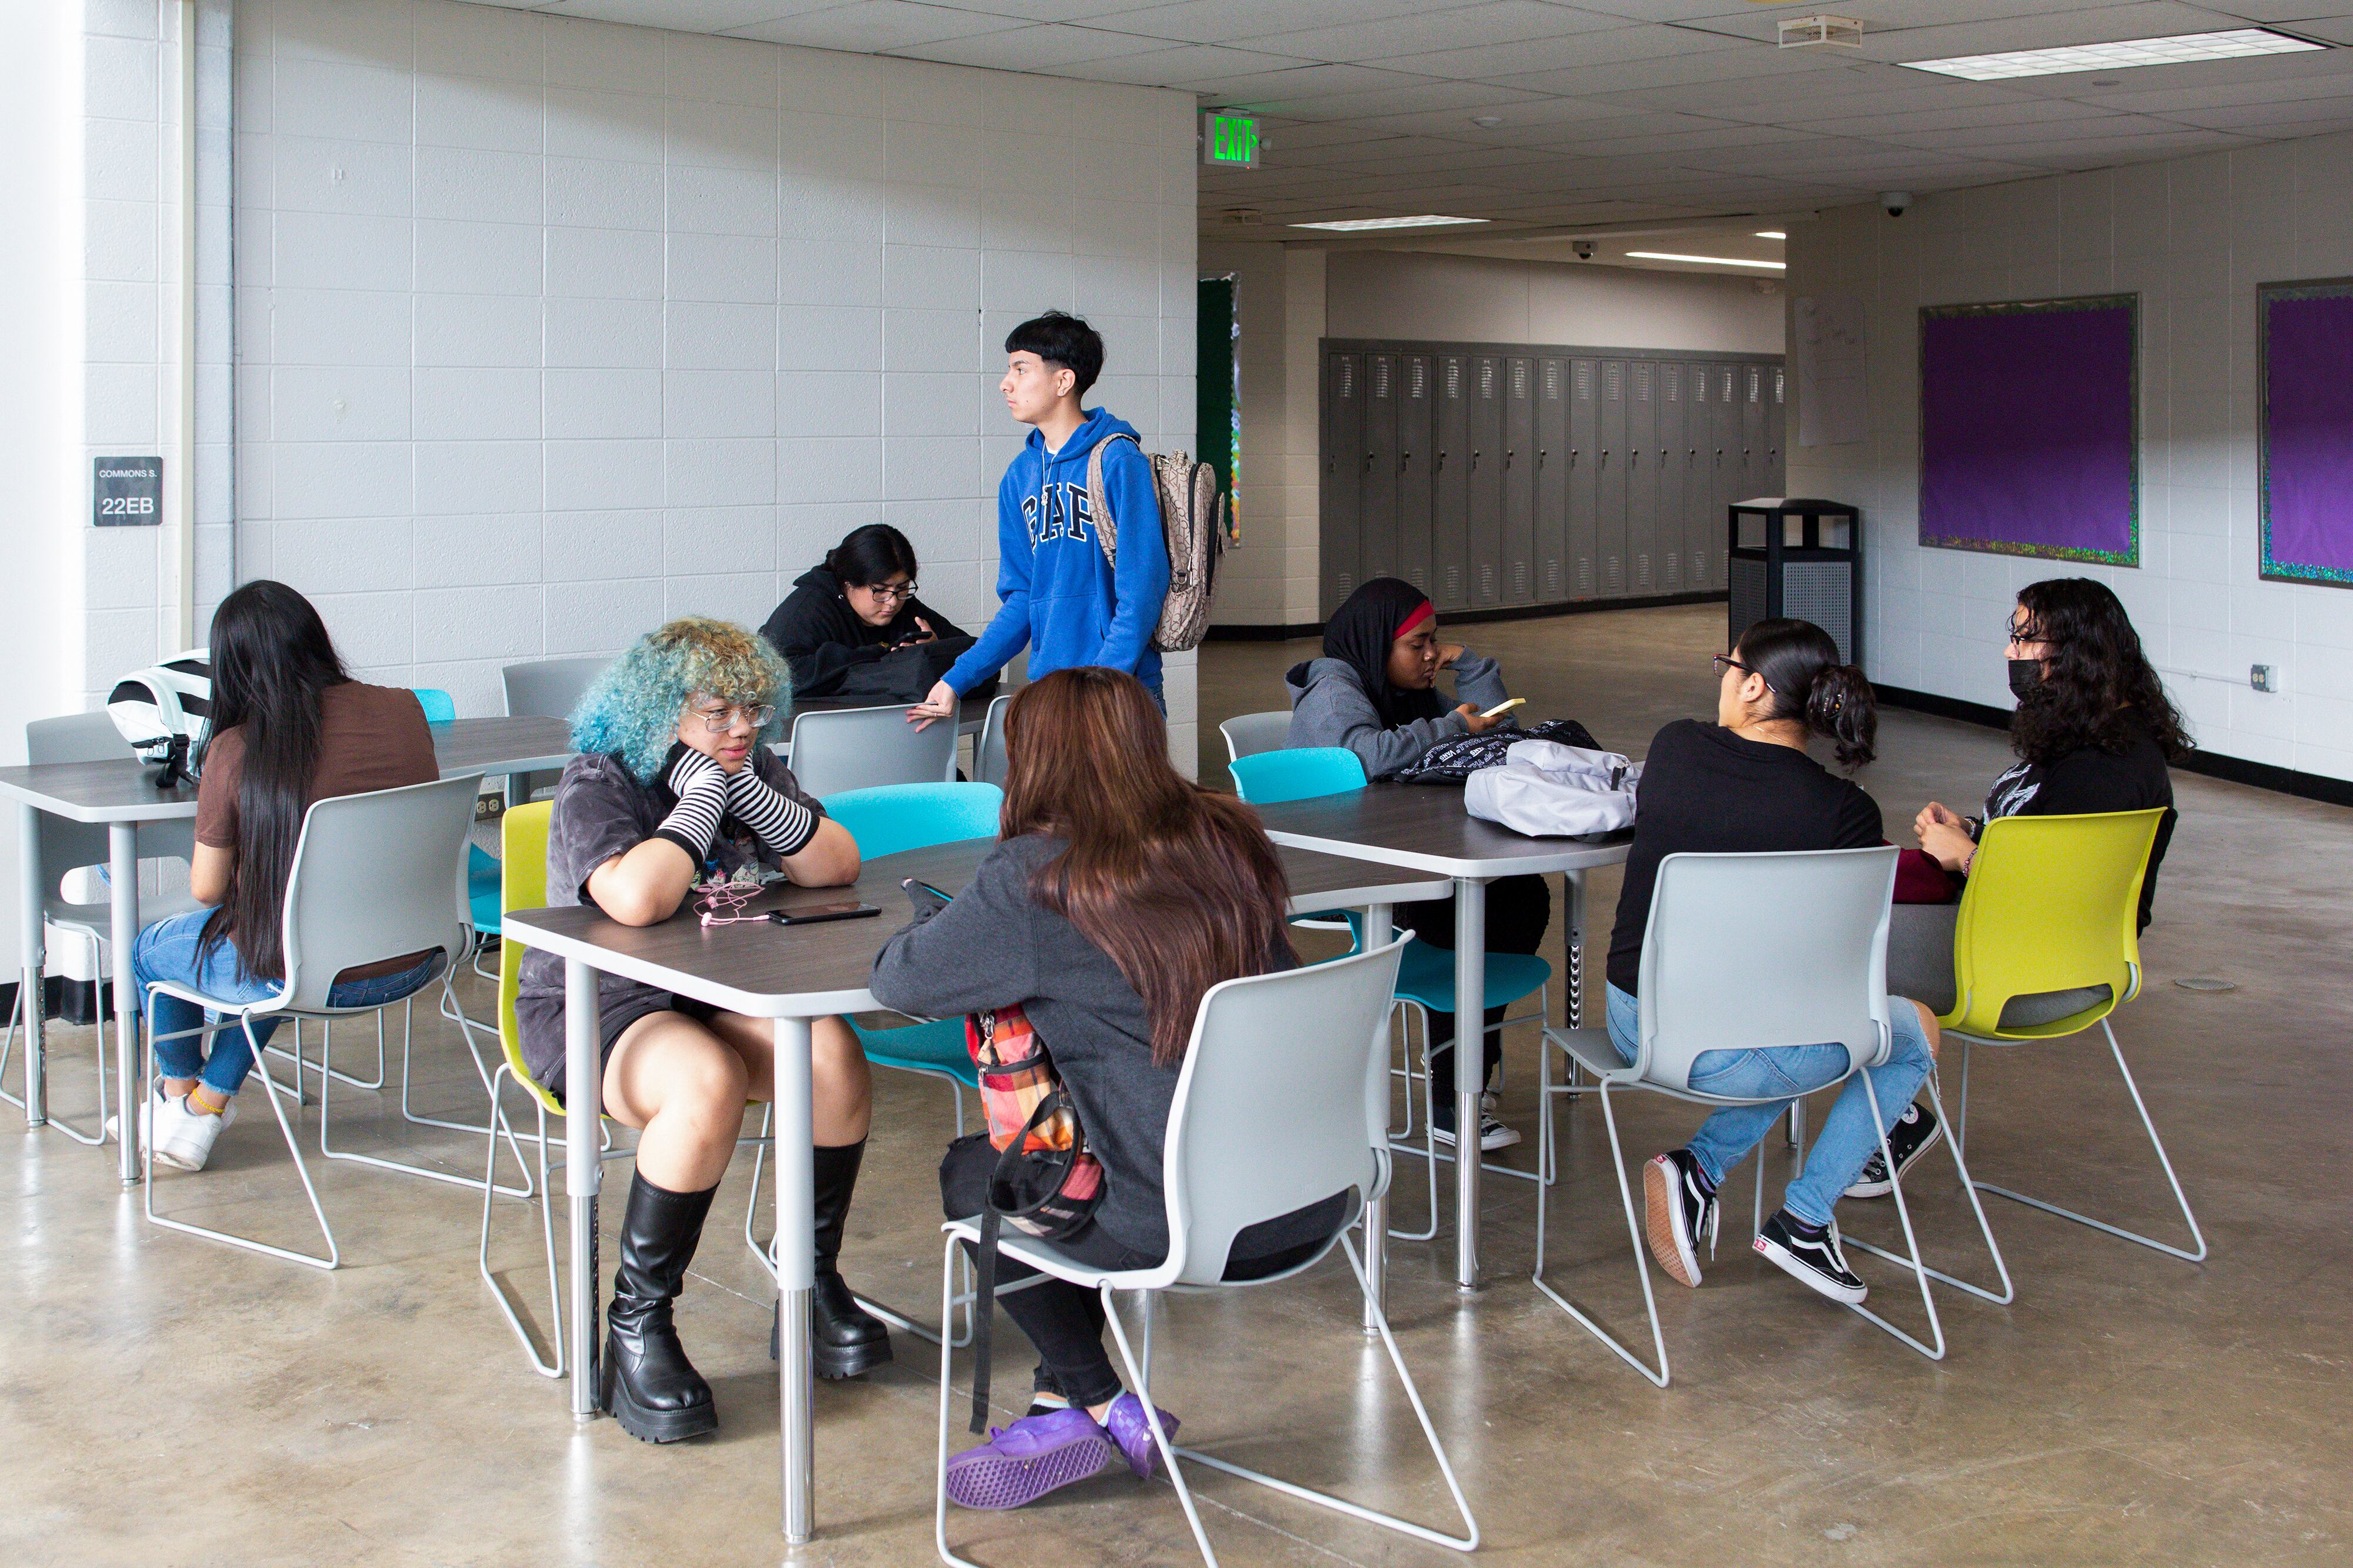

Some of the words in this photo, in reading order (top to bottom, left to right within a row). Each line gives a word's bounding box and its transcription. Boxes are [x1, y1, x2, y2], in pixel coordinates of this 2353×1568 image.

[1214, 116, 1253, 162] EXIT
[99, 469, 147, 478] COMMONS
[148, 469, 158, 478] S.
[102, 497, 155, 515] 22EB
[1439, 750, 1457, 763] VANS
